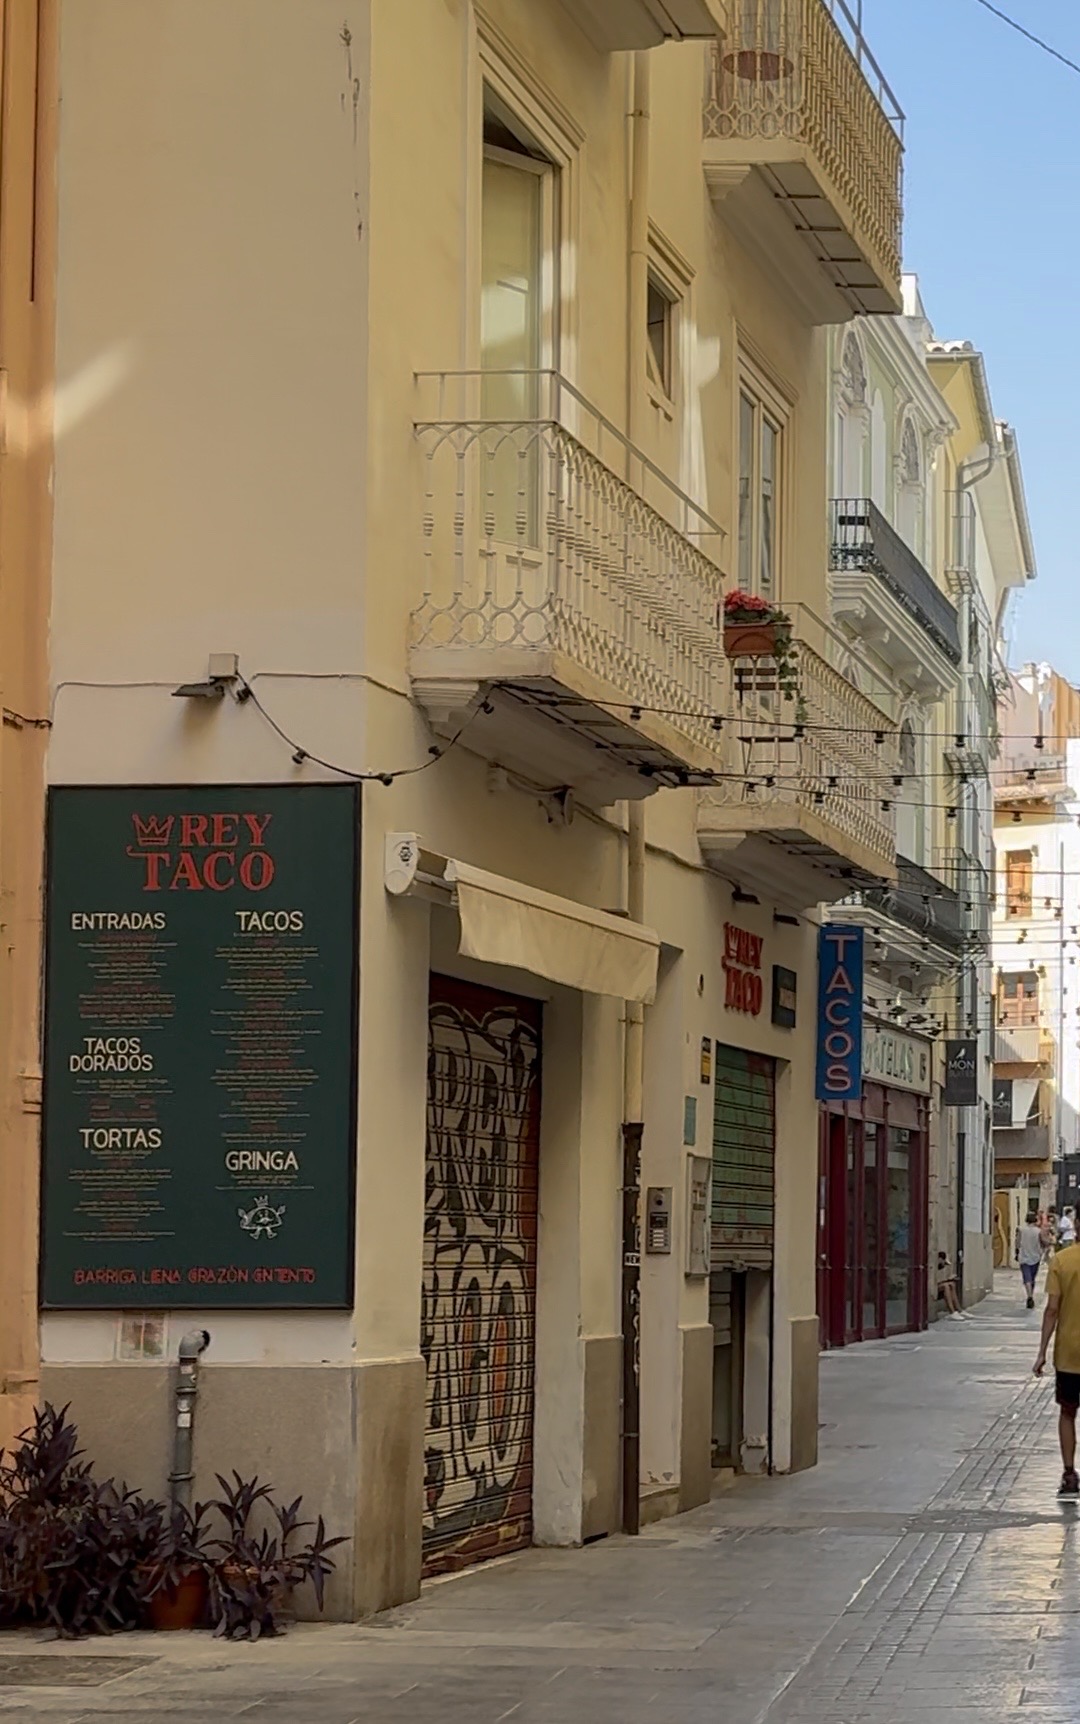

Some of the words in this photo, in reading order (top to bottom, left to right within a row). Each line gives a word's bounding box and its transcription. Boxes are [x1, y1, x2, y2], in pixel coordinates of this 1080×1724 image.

[179, 813, 273, 847] REY
[126, 845, 275, 891] TACO
[71, 912, 166, 930] ENTRADAS
[235, 911, 304, 931] TACOS
[736, 928, 764, 969] REY
[721, 955, 763, 1016] TACO
[825, 934, 858, 1092] TACOS
[84, 1037, 141, 1054] TACOS
[69, 1055, 153, 1072] DORADOS
[79, 1128, 162, 1149] TORTAS
[225, 1151, 299, 1171] GRINGA
[74, 1269, 137, 1284] BARRIGA
